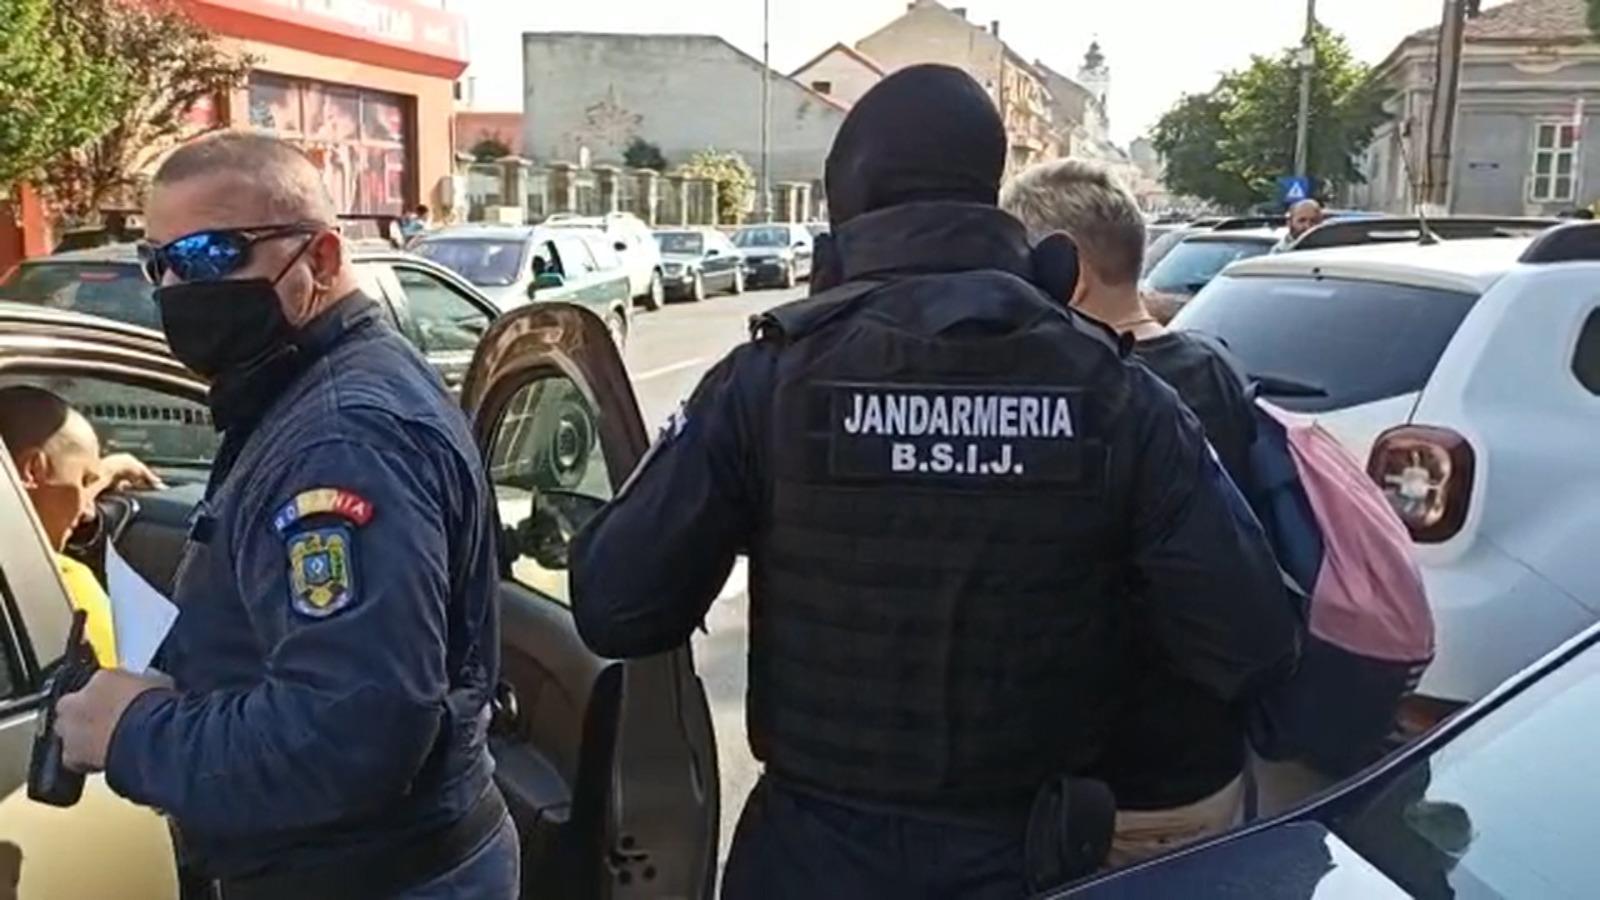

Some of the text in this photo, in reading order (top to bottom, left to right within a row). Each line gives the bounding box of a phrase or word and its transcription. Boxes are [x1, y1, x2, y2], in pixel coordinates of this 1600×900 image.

[844, 394, 1074, 437] JANDARMERIA
[891, 443, 1024, 474] B.S.I.J.
[273, 489, 369, 531] ROANIA
